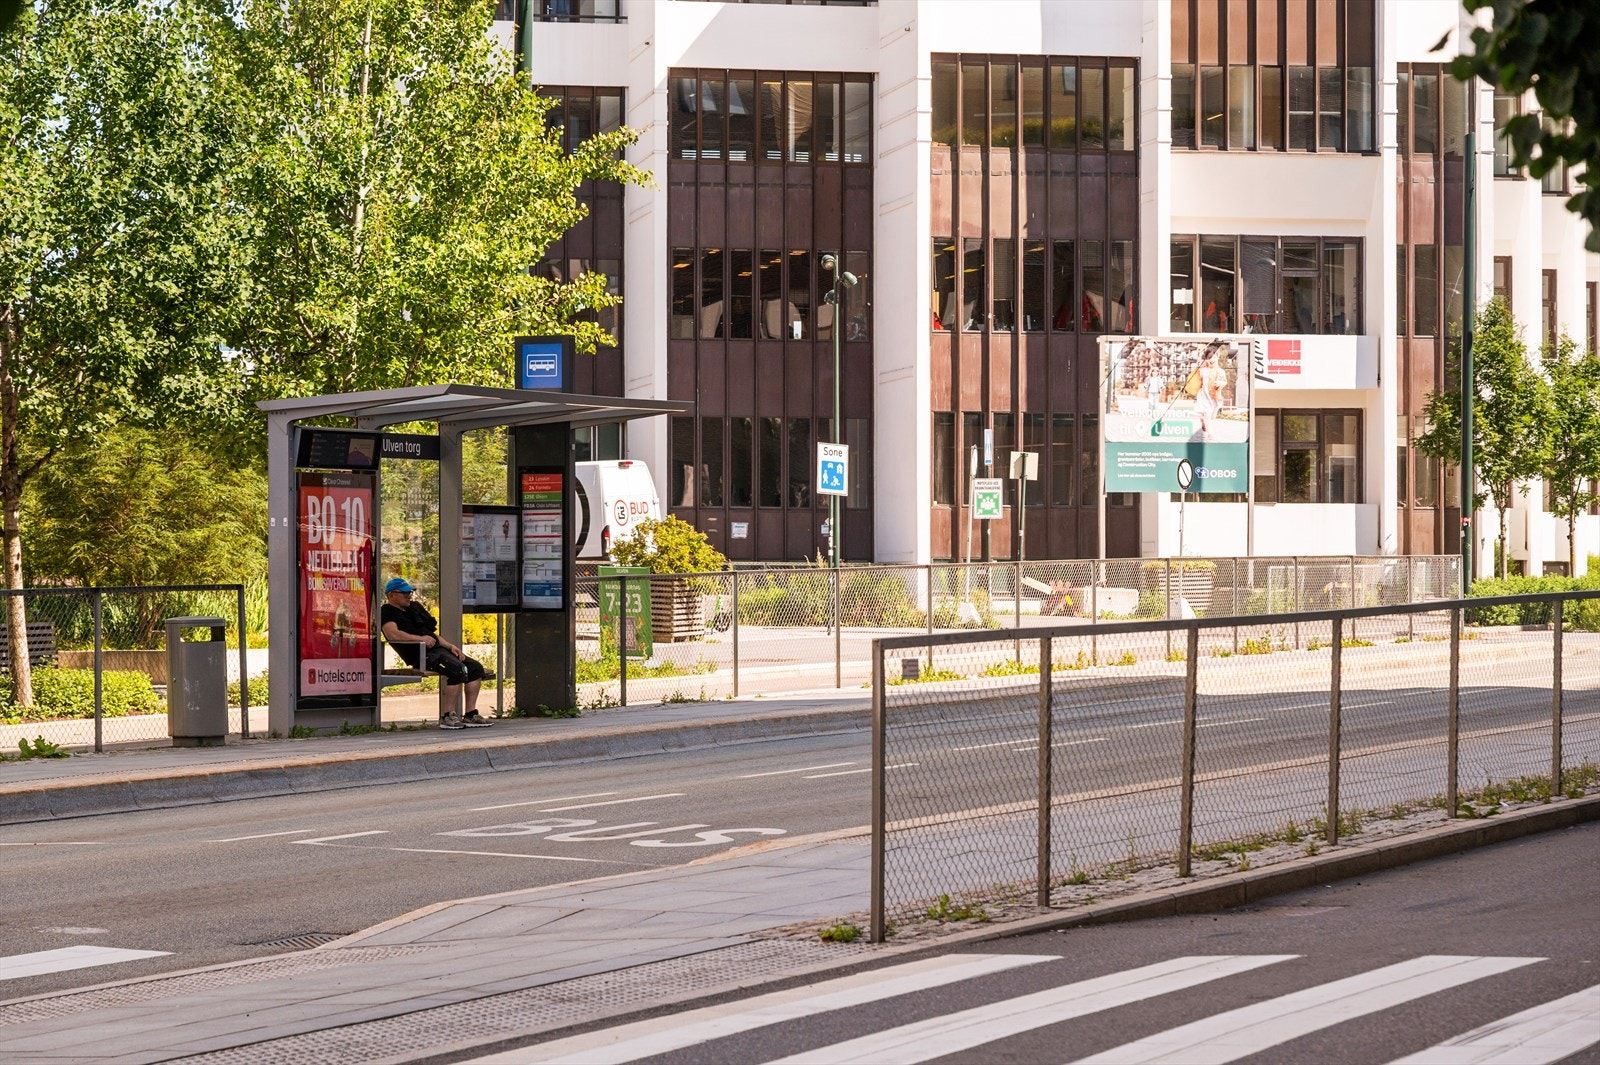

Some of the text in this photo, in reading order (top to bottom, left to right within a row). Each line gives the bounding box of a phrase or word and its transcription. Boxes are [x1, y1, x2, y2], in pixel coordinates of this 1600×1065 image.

[1155, 421, 1189, 435] Ulven
[382, 438, 404, 453] Ulven
[405, 441, 421, 456] torg
[823, 446, 843, 457] Sone
[1209, 469, 1237, 478] OBOS
[630, 502, 649, 514] BUD
[307, 495, 366, 546] BO 10
[317, 669, 366, 683] Hotels.com
[431, 817, 788, 848] BUS
